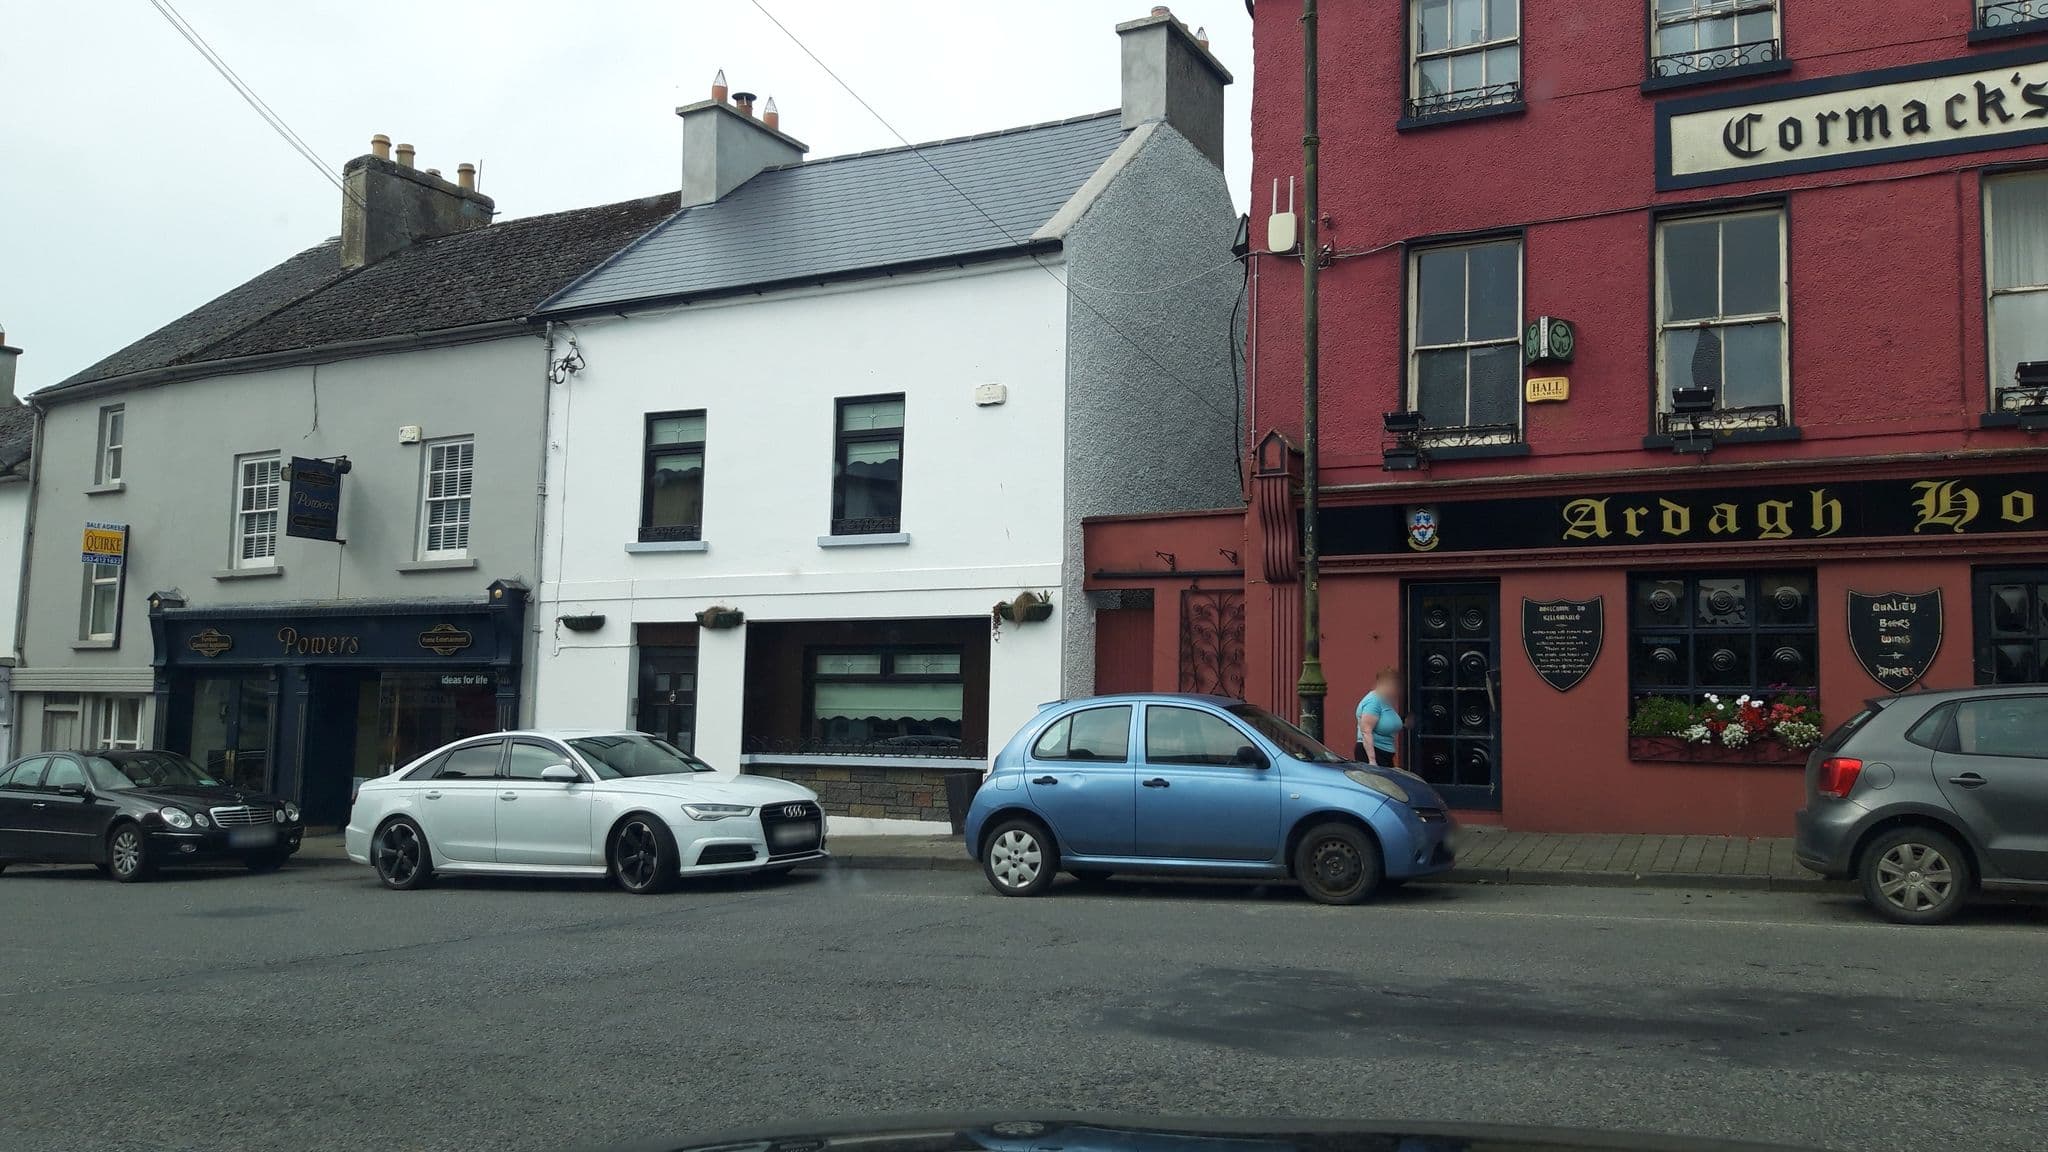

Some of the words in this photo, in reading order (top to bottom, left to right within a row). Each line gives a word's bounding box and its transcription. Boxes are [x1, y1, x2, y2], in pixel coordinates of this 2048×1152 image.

[1723, 72, 2048, 159] Cormack's
[1532, 381, 1562, 393] HALL
[295, 491, 334, 511] Powers
[1562, 489, 1843, 540] Ardagh
[86, 535, 122, 552] QUIRKE
[278, 627, 359, 654] Powers
[441, 675, 462, 685] ideas
[463, 675, 475, 685] for
[475, 675, 488, 686] life
